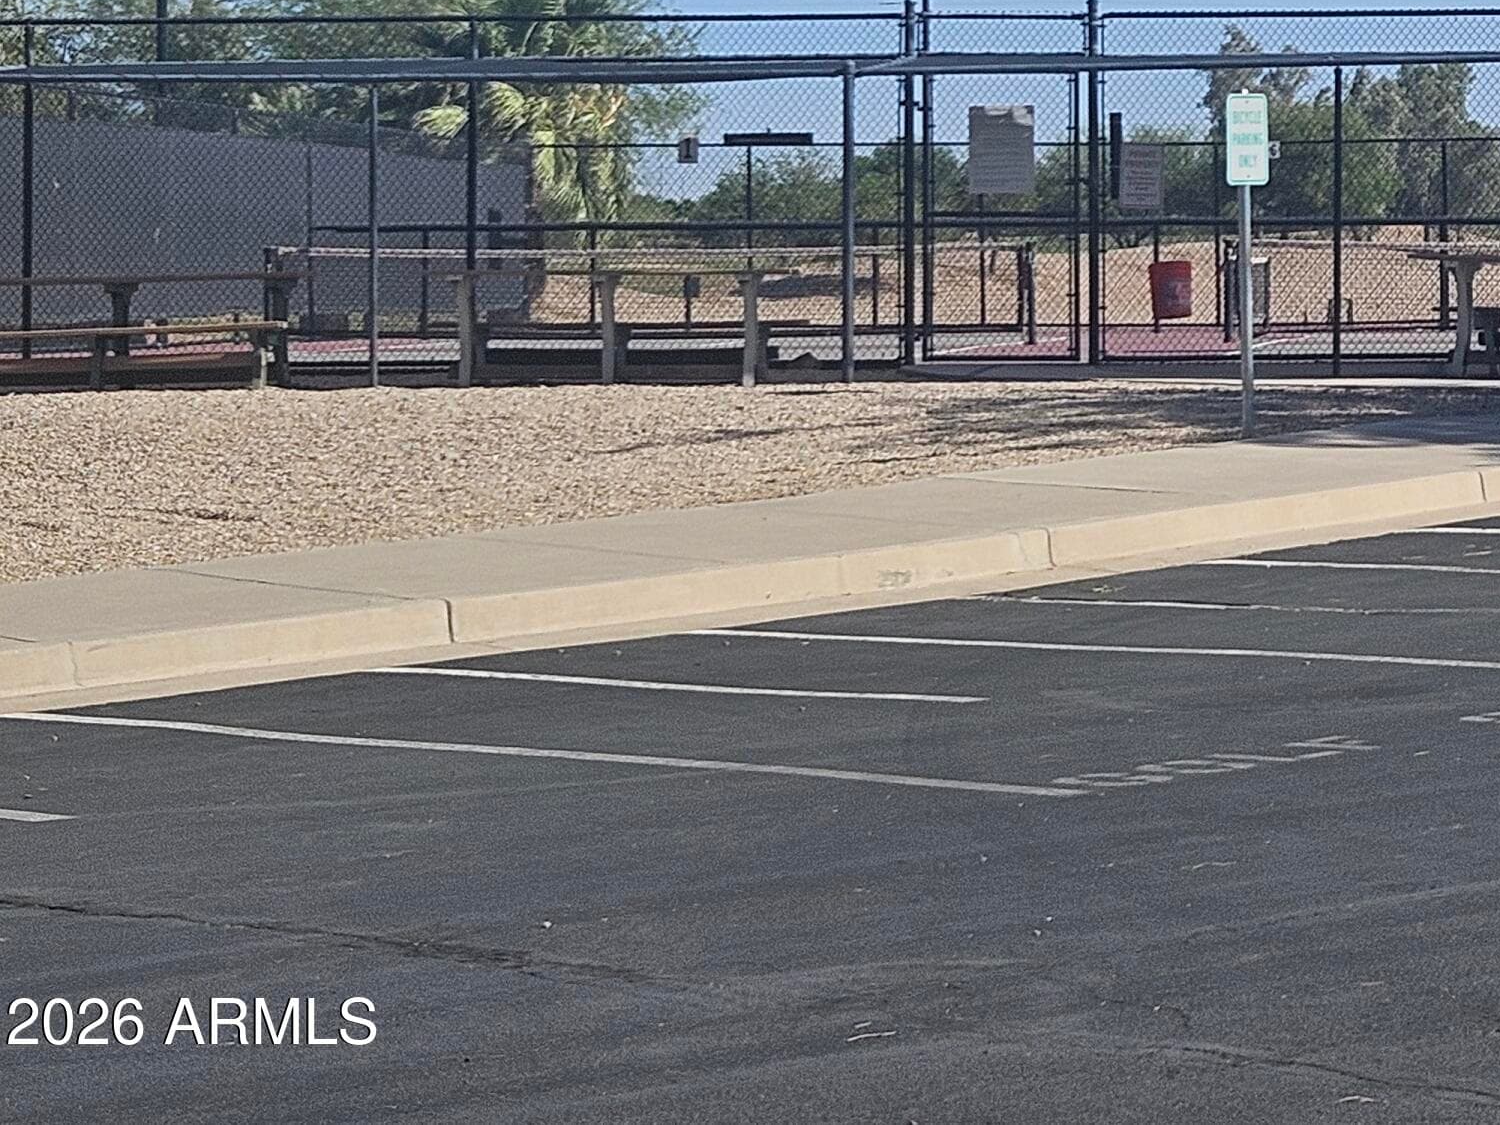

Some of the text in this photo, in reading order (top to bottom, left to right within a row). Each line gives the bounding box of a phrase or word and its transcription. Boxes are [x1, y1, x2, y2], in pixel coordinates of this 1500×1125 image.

[1232, 132, 1264, 146] PARKING
[1238, 154, 1257, 168] ONLY
[1051, 734, 1382, 787] GOLF
